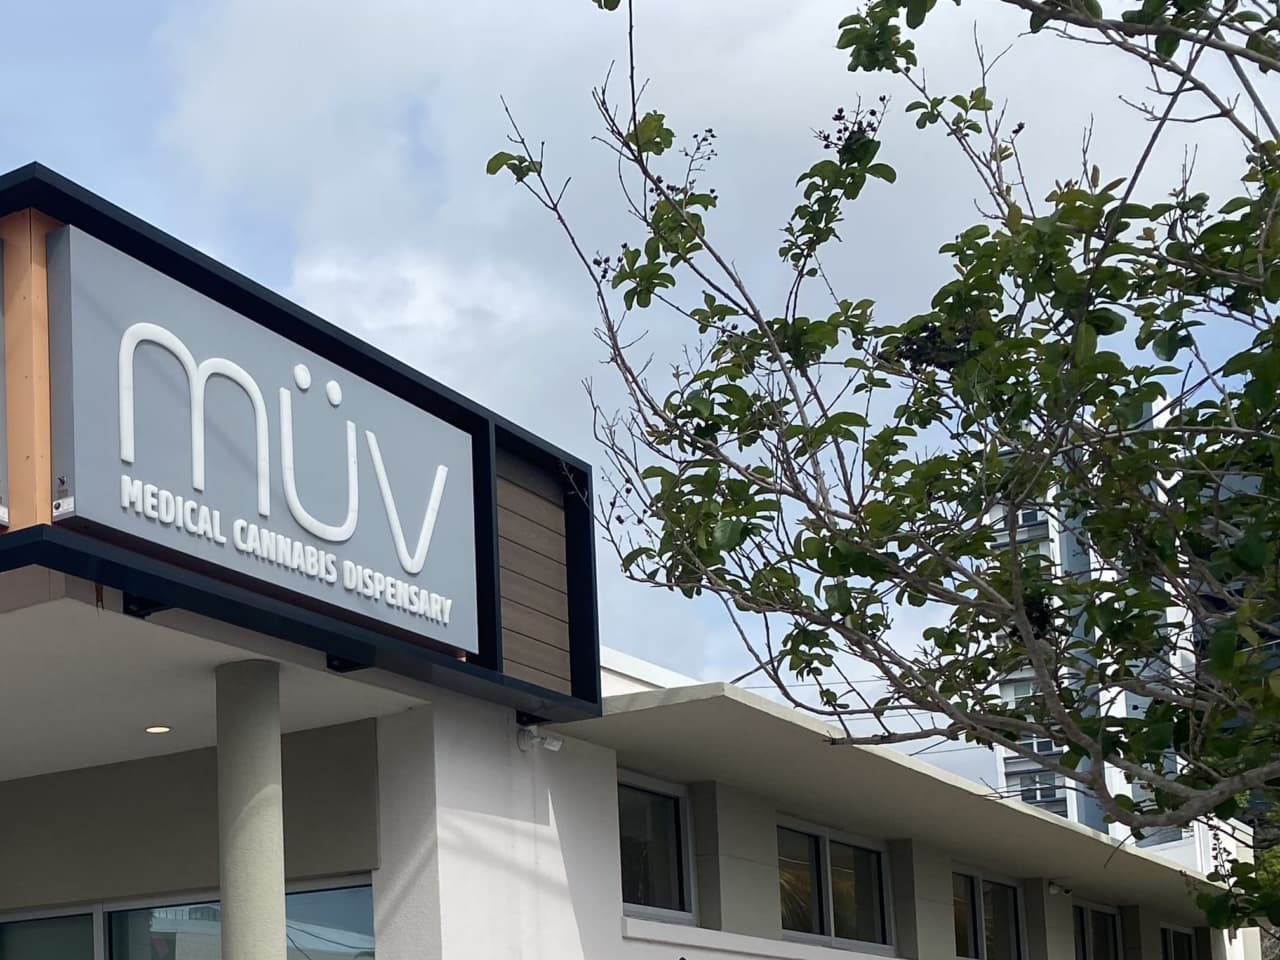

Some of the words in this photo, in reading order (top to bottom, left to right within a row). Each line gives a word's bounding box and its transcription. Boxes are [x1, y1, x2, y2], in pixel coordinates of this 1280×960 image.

[120, 475, 227, 545] MEDICAL
[232, 518, 338, 584] CANNABIS
[342, 559, 453, 625] DISPENSARY
